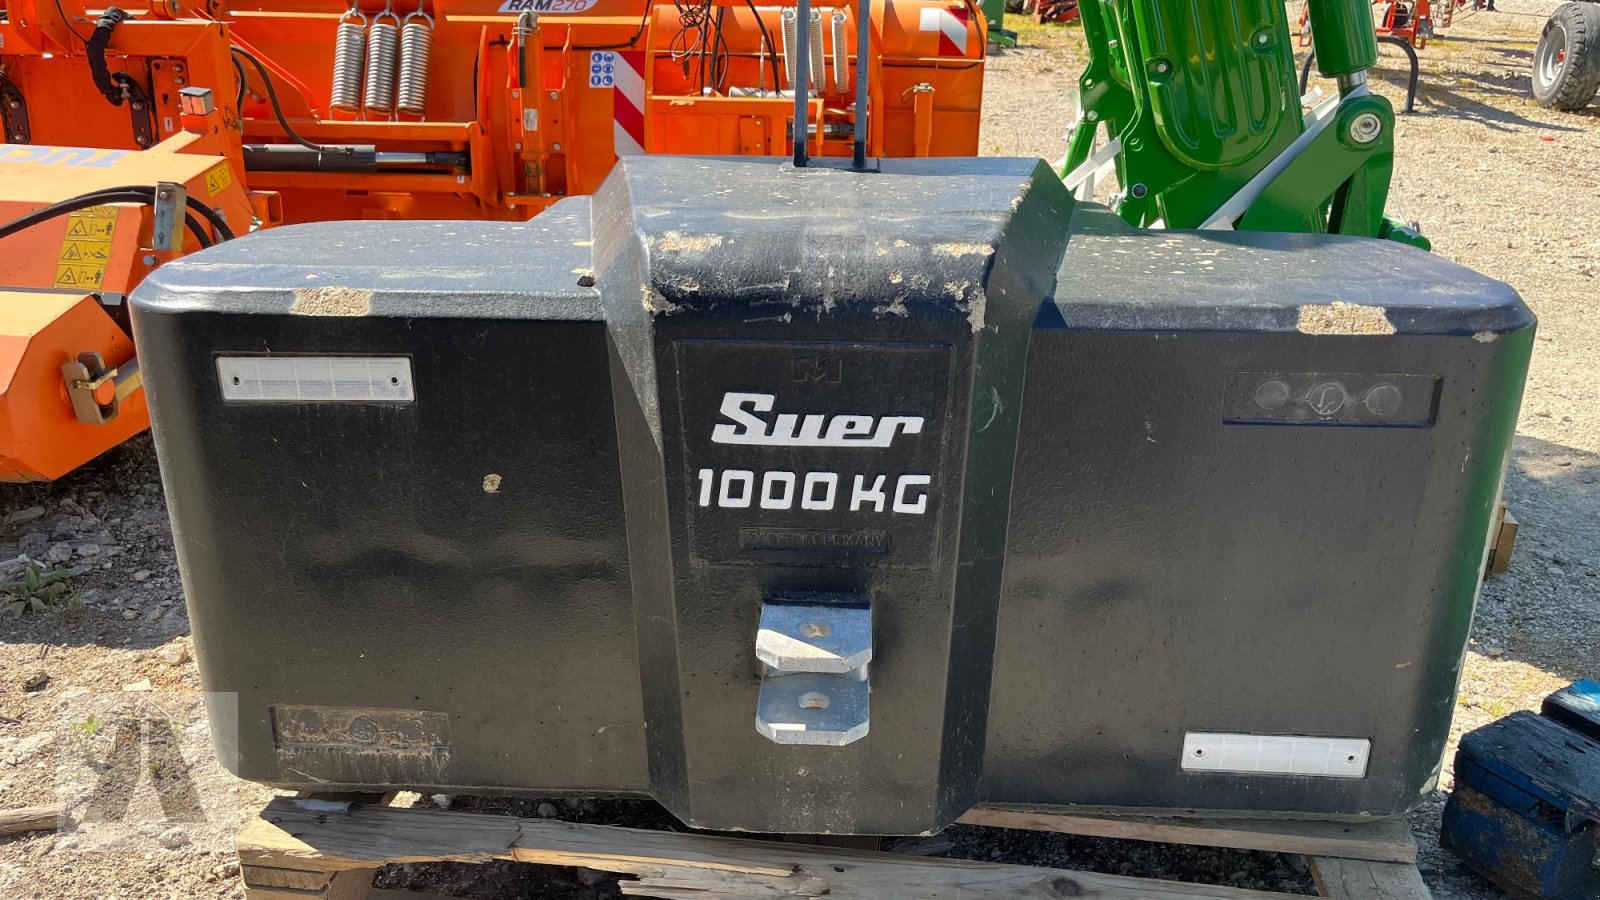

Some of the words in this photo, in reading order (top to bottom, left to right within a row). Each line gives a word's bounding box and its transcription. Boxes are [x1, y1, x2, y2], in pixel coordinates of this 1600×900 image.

[711, 392, 925, 448] Suer
[699, 468, 839, 511] 1000
[850, 474, 932, 515] KG
[750, 531, 789, 546] MADE
[792, 532, 808, 546] IN
[811, 532, 886, 548] GERMANY
